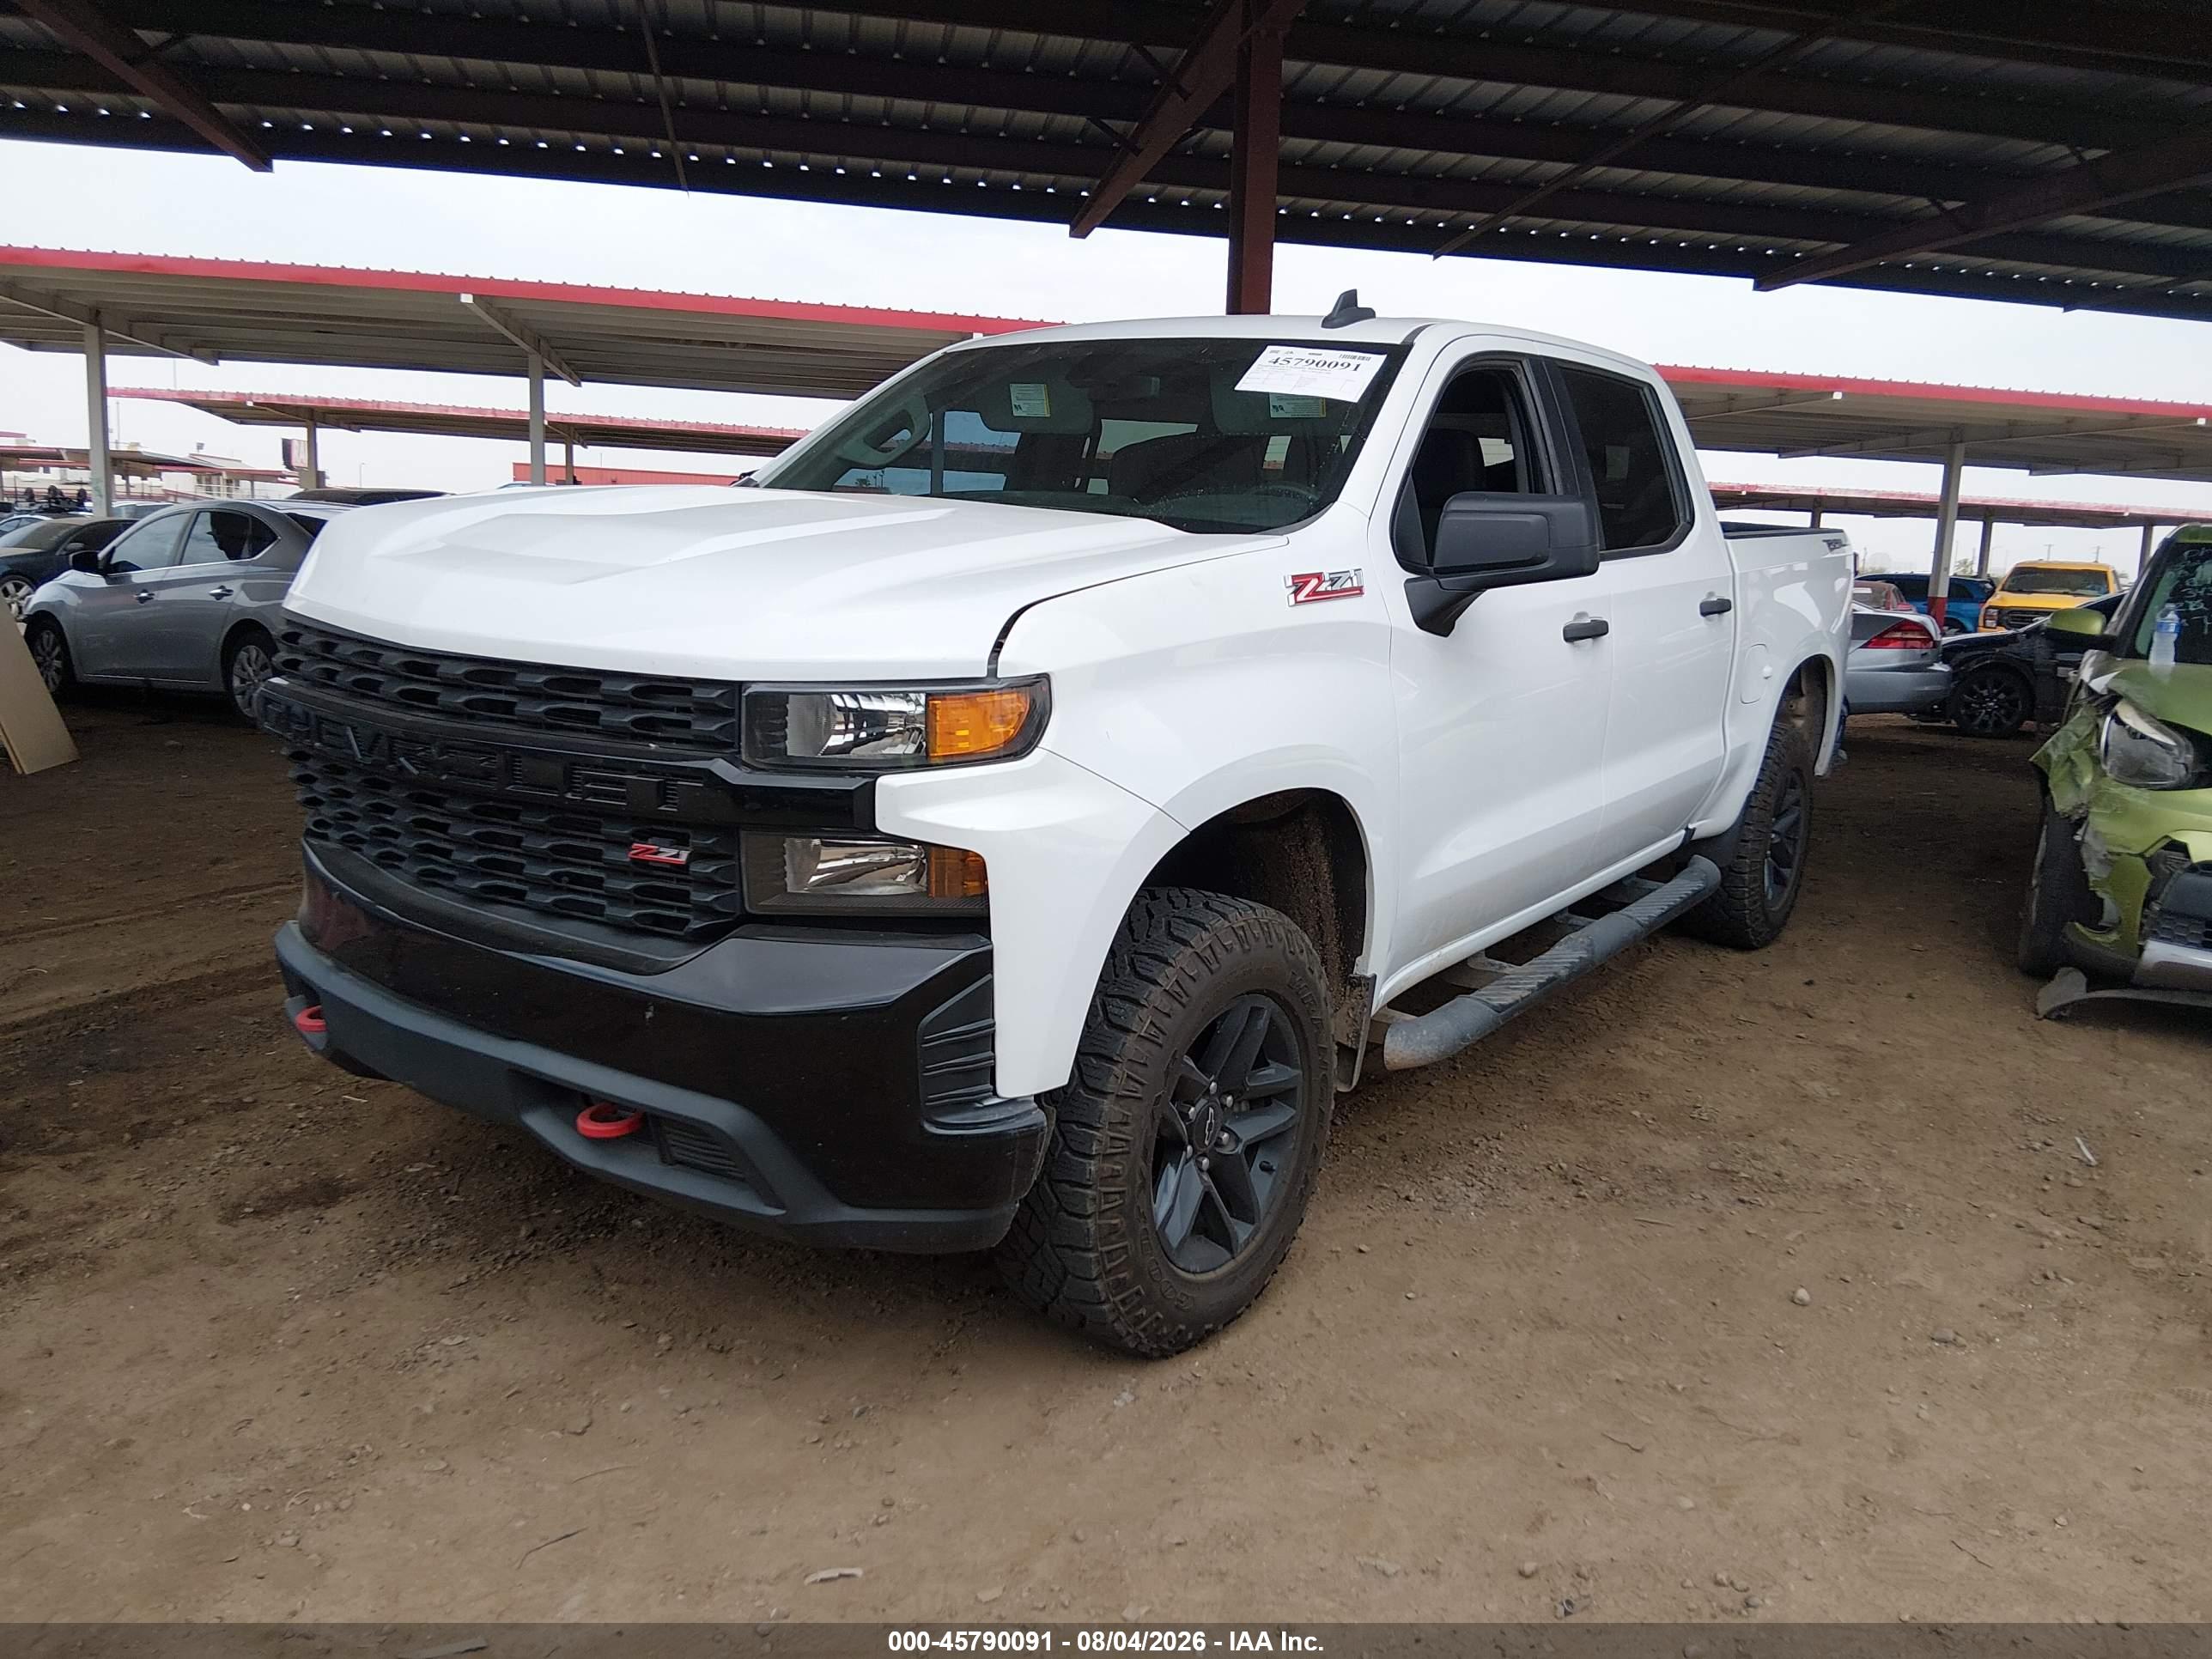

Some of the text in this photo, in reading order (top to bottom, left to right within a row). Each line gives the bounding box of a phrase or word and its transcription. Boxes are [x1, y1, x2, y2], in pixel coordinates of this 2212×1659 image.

[1267, 356, 1362, 372] 45790091
[1285, 568, 1364, 605] Z71
[628, 842, 690, 864] Z71
